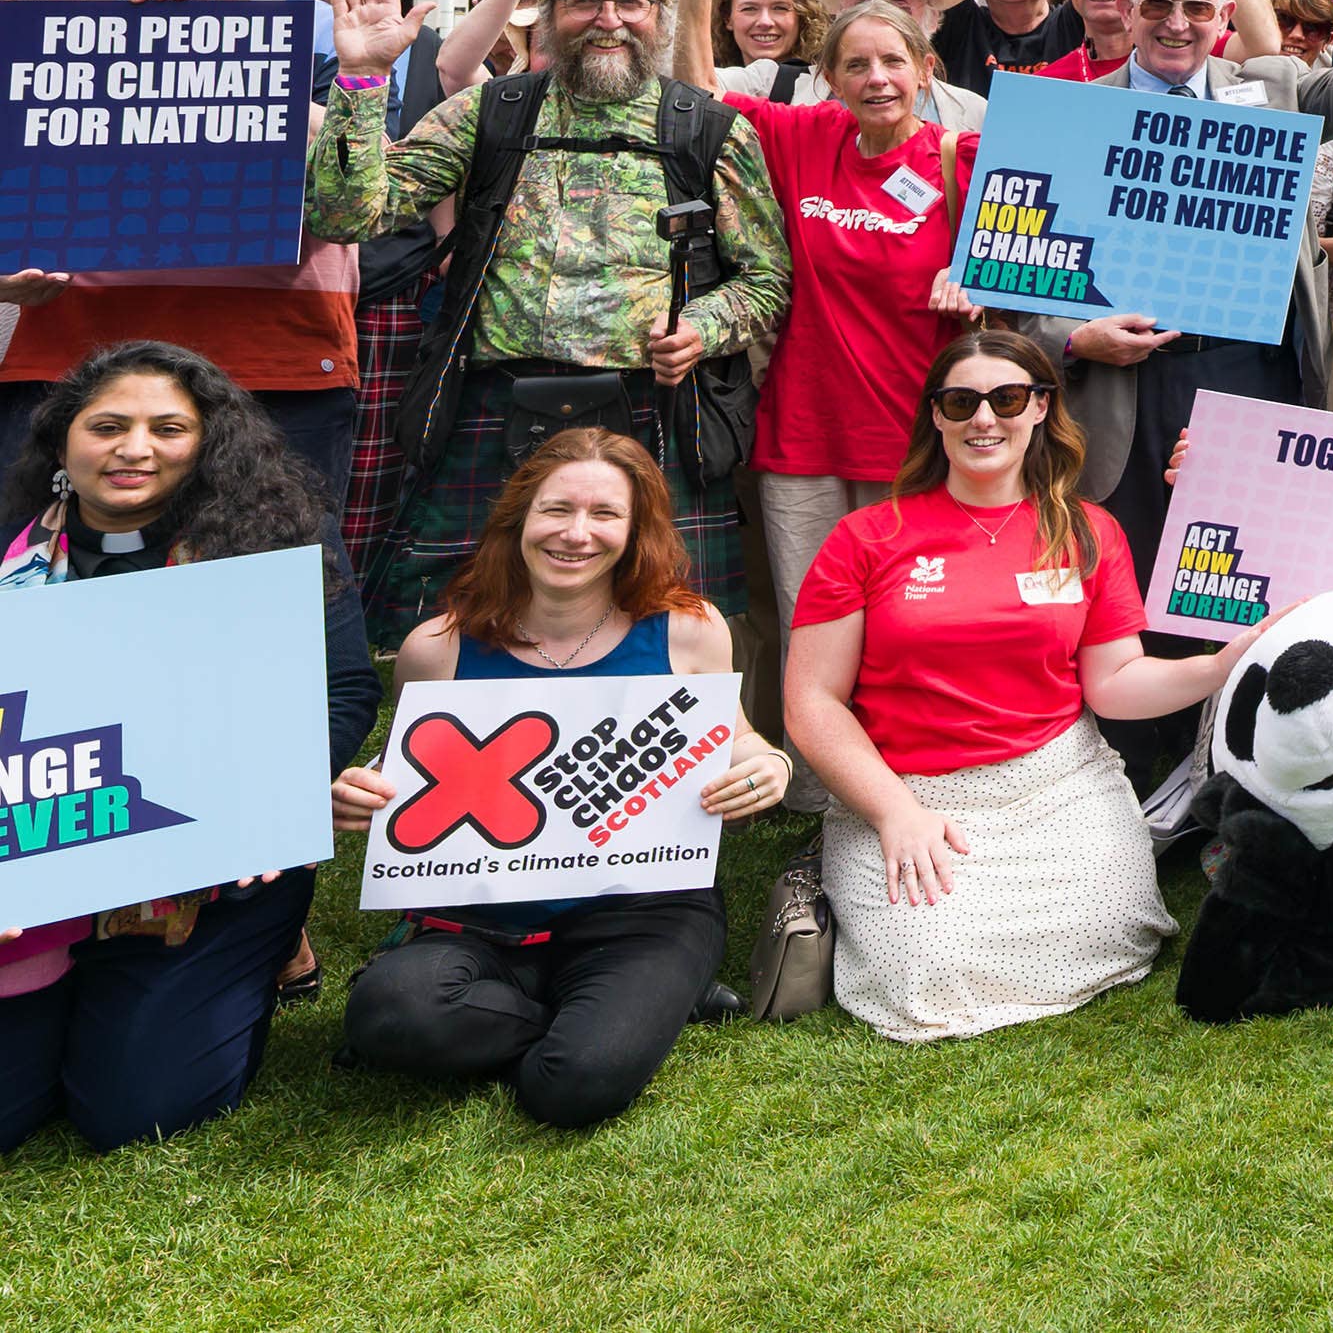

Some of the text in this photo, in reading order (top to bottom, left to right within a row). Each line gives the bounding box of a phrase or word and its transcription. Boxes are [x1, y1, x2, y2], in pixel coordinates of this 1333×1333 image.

[42, 15, 293, 54] FOR PEOPLE
[9, 61, 290, 101] FOR CLIMATE
[24, 105, 288, 146] FOR NATURE
[1132, 110, 1307, 163] FOR PEOPLE
[983, 174, 1042, 207] ACT
[1104, 146, 1300, 201] FOR CLIMATE
[977, 202, 1047, 236] NOW
[1108, 185, 1293, 240] FOR NATURE
[971, 230, 1083, 271] CHANGE
[963, 258, 1089, 300] FOREVER
[1185, 526, 1231, 552] ACT
[1179, 548, 1234, 575] NOW
[904, 592, 927, 600] Trust
[906, 585, 945, 593] National
[1174, 570, 1262, 603] CHANGE
[1168, 591, 1266, 625] FOREVER
[587, 724, 730, 848] SCOTLAND
[0, 784, 129, 857] VER
[507, 851, 599, 873] climate
[606, 845, 709, 867] coalition
